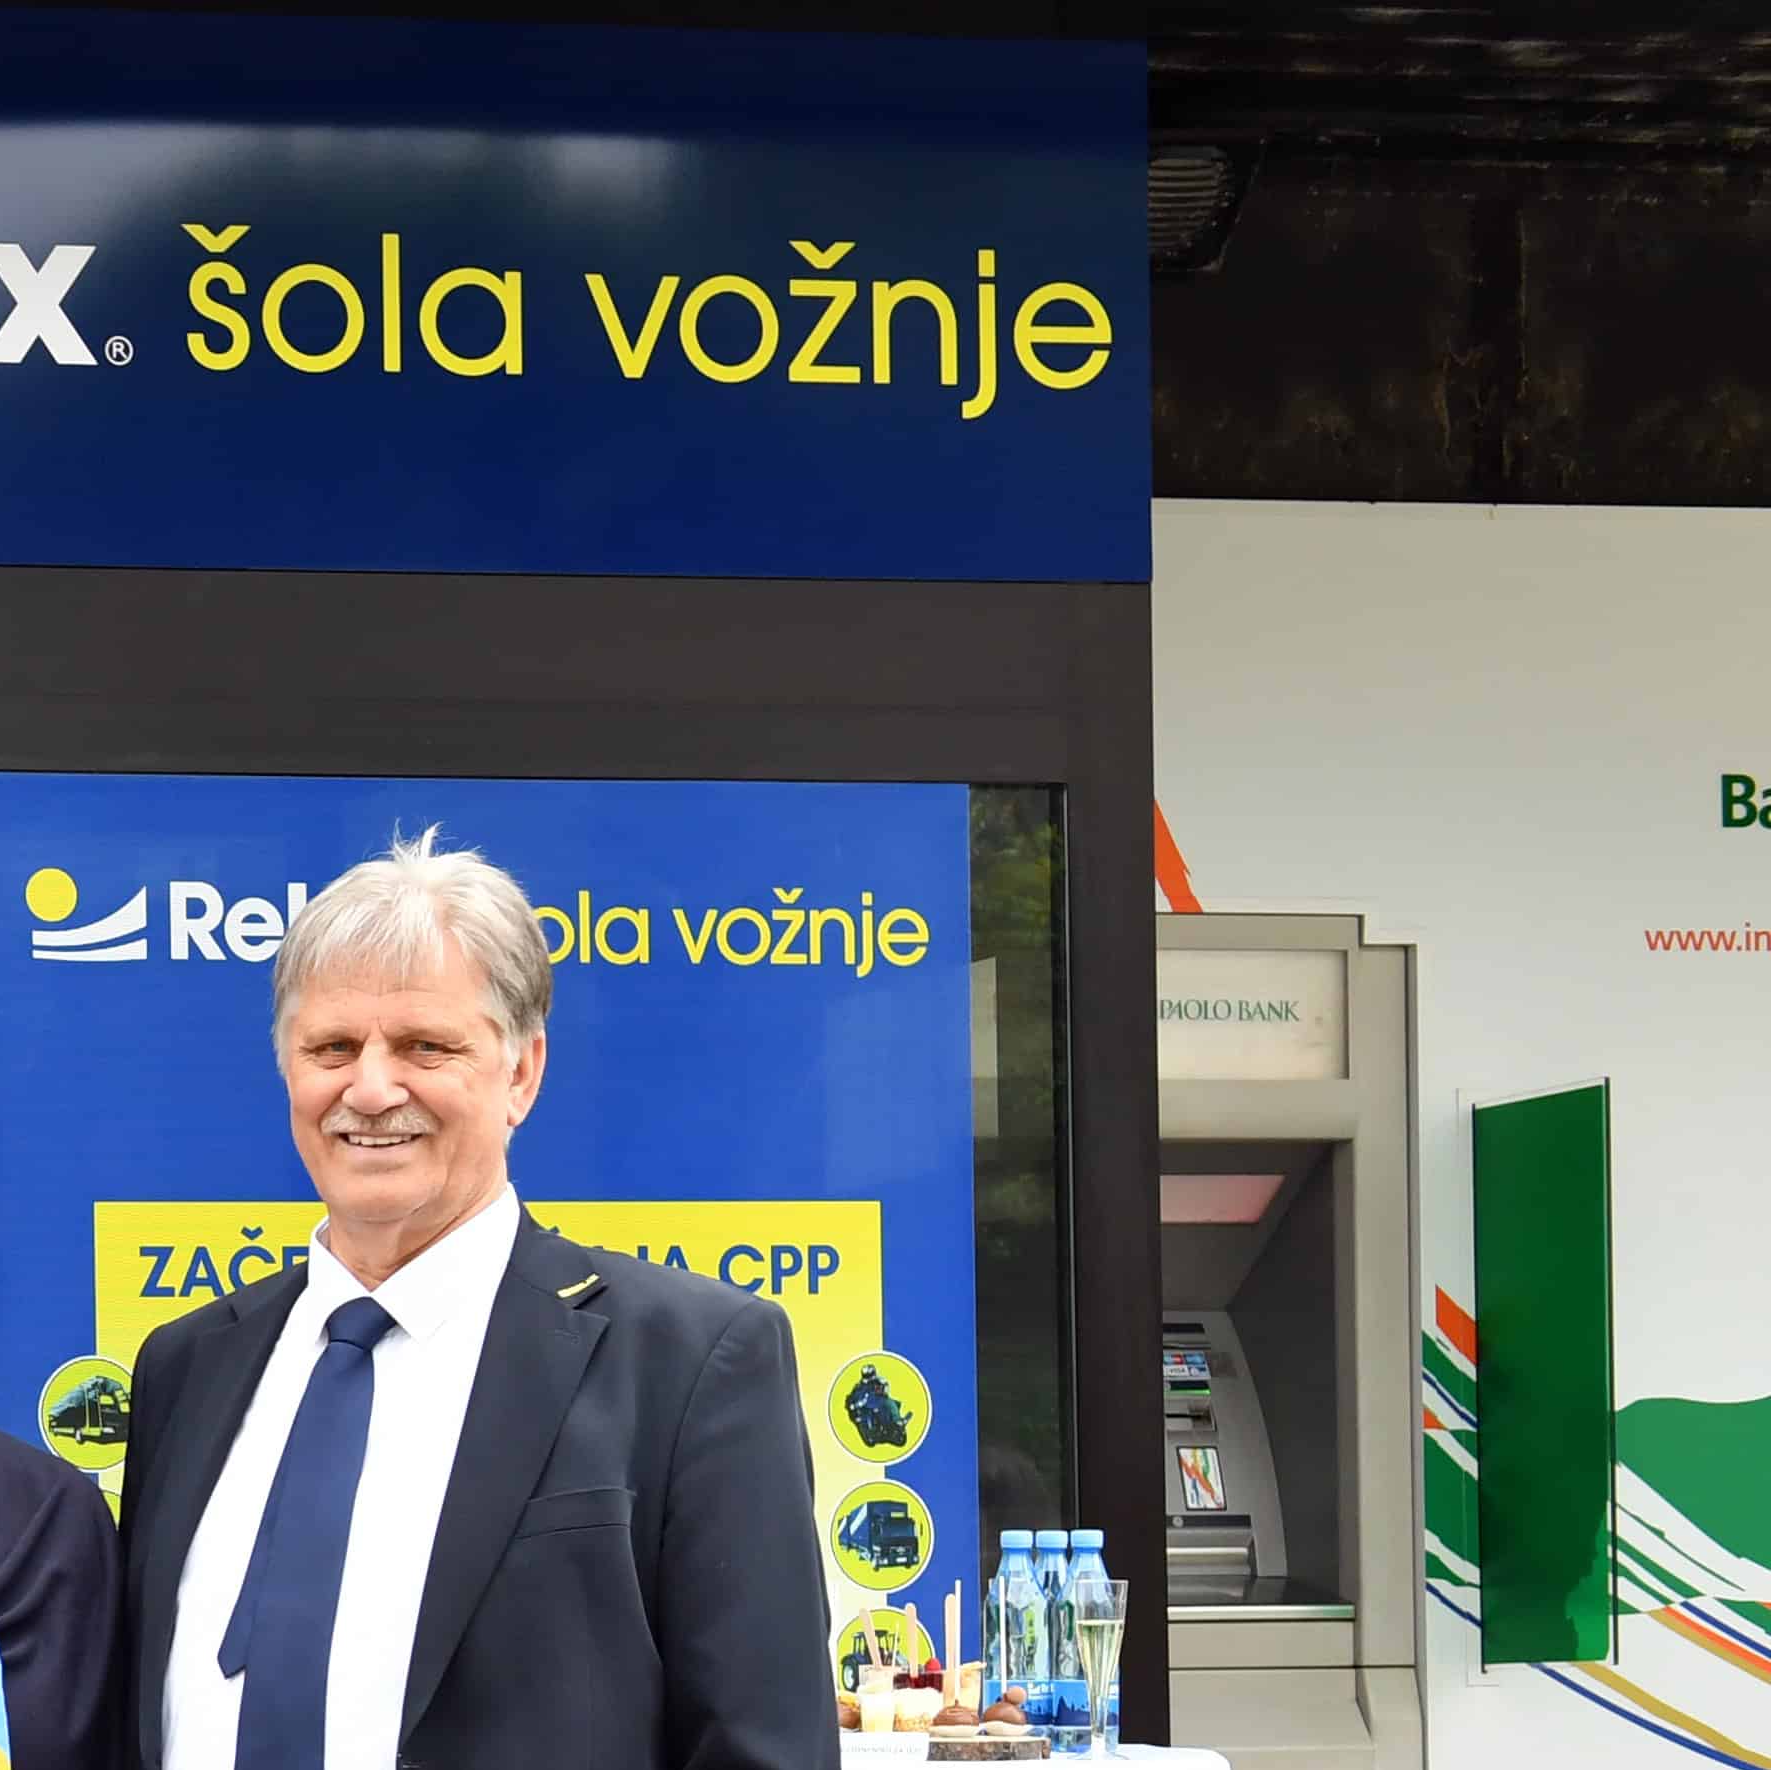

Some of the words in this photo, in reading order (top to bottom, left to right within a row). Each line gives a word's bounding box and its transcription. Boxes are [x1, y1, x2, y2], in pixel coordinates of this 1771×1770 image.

[182, 224, 523, 377] šola
[587, 241, 1113, 419] vožnje
[532, 888, 650, 966] ola
[673, 887, 930, 978] vožnje
[1644, 922, 1771, 951] www.in
[1159, 999, 1232, 1020] PAOLO
[1238, 999, 1300, 1021] BANK
[718, 1244, 840, 1294] CPP
